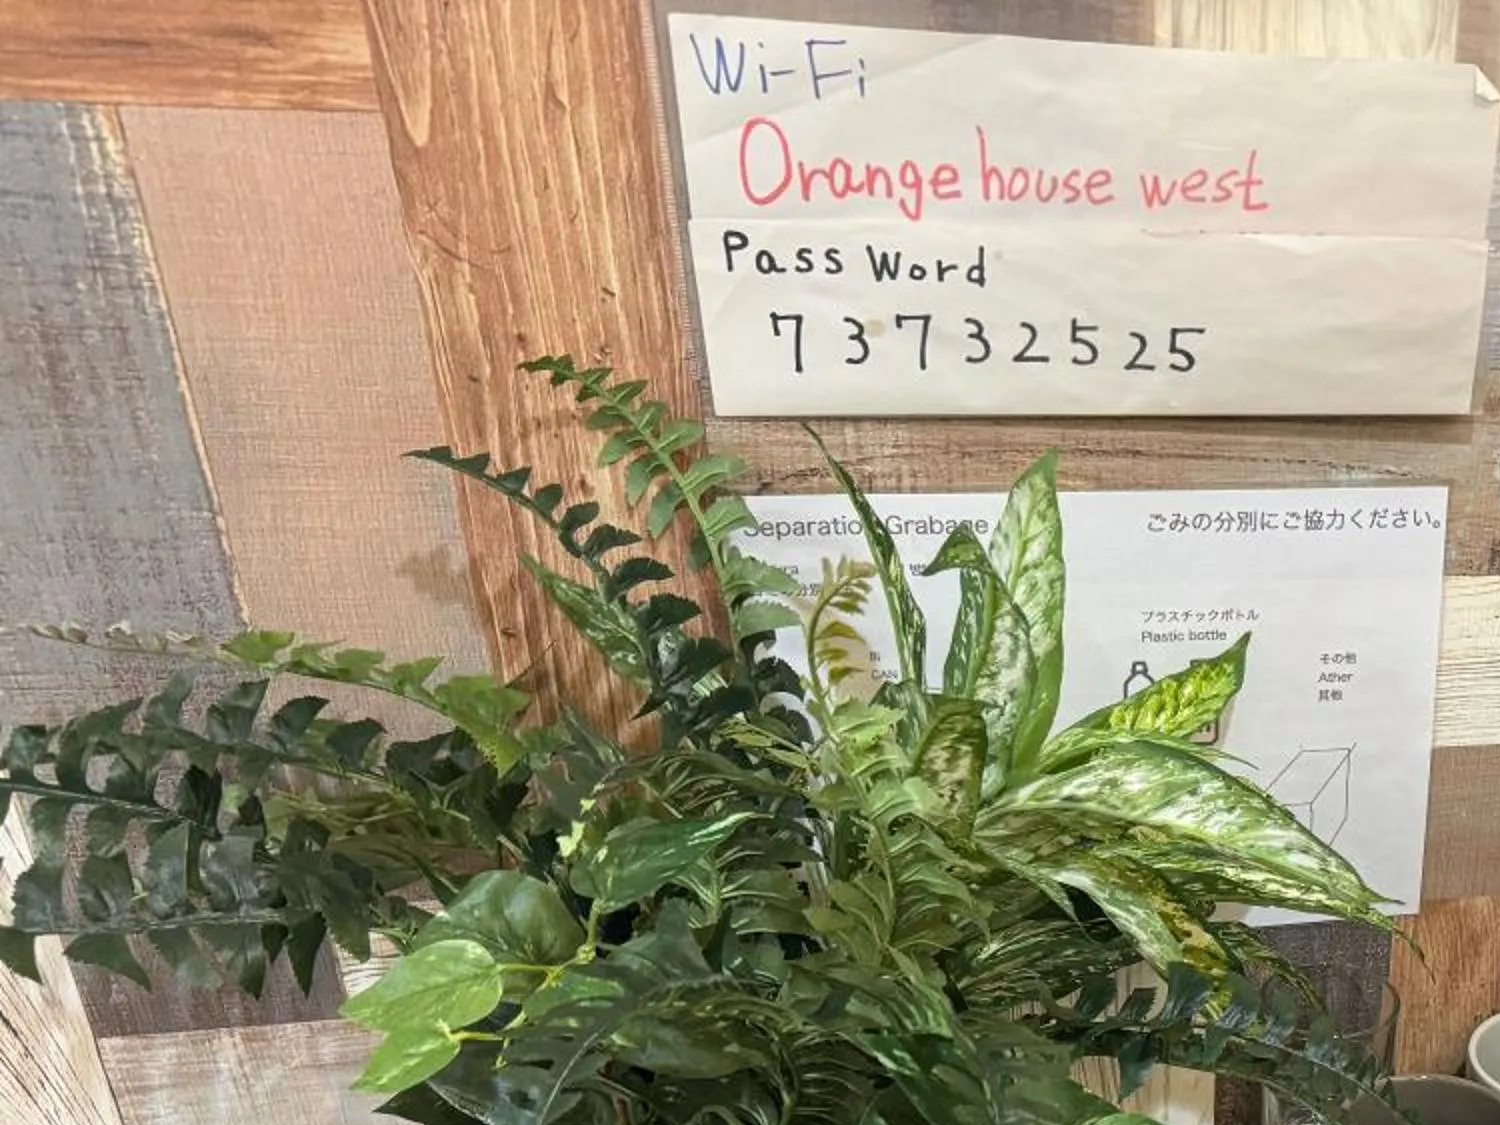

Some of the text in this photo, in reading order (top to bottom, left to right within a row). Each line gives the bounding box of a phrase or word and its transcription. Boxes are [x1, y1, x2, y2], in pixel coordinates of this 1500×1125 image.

[689, 34, 868, 100] Wi-Fi
[738, 117, 1271, 221] Orange house west
[721, 231, 988, 286] Pass Word
[770, 312, 1206, 372] 73732525
[743, 515, 863, 540] eparatio
[1147, 508, 1441, 532] ごみの分別にご協力ください。
[1141, 629, 1227, 642] Plastic bottle
